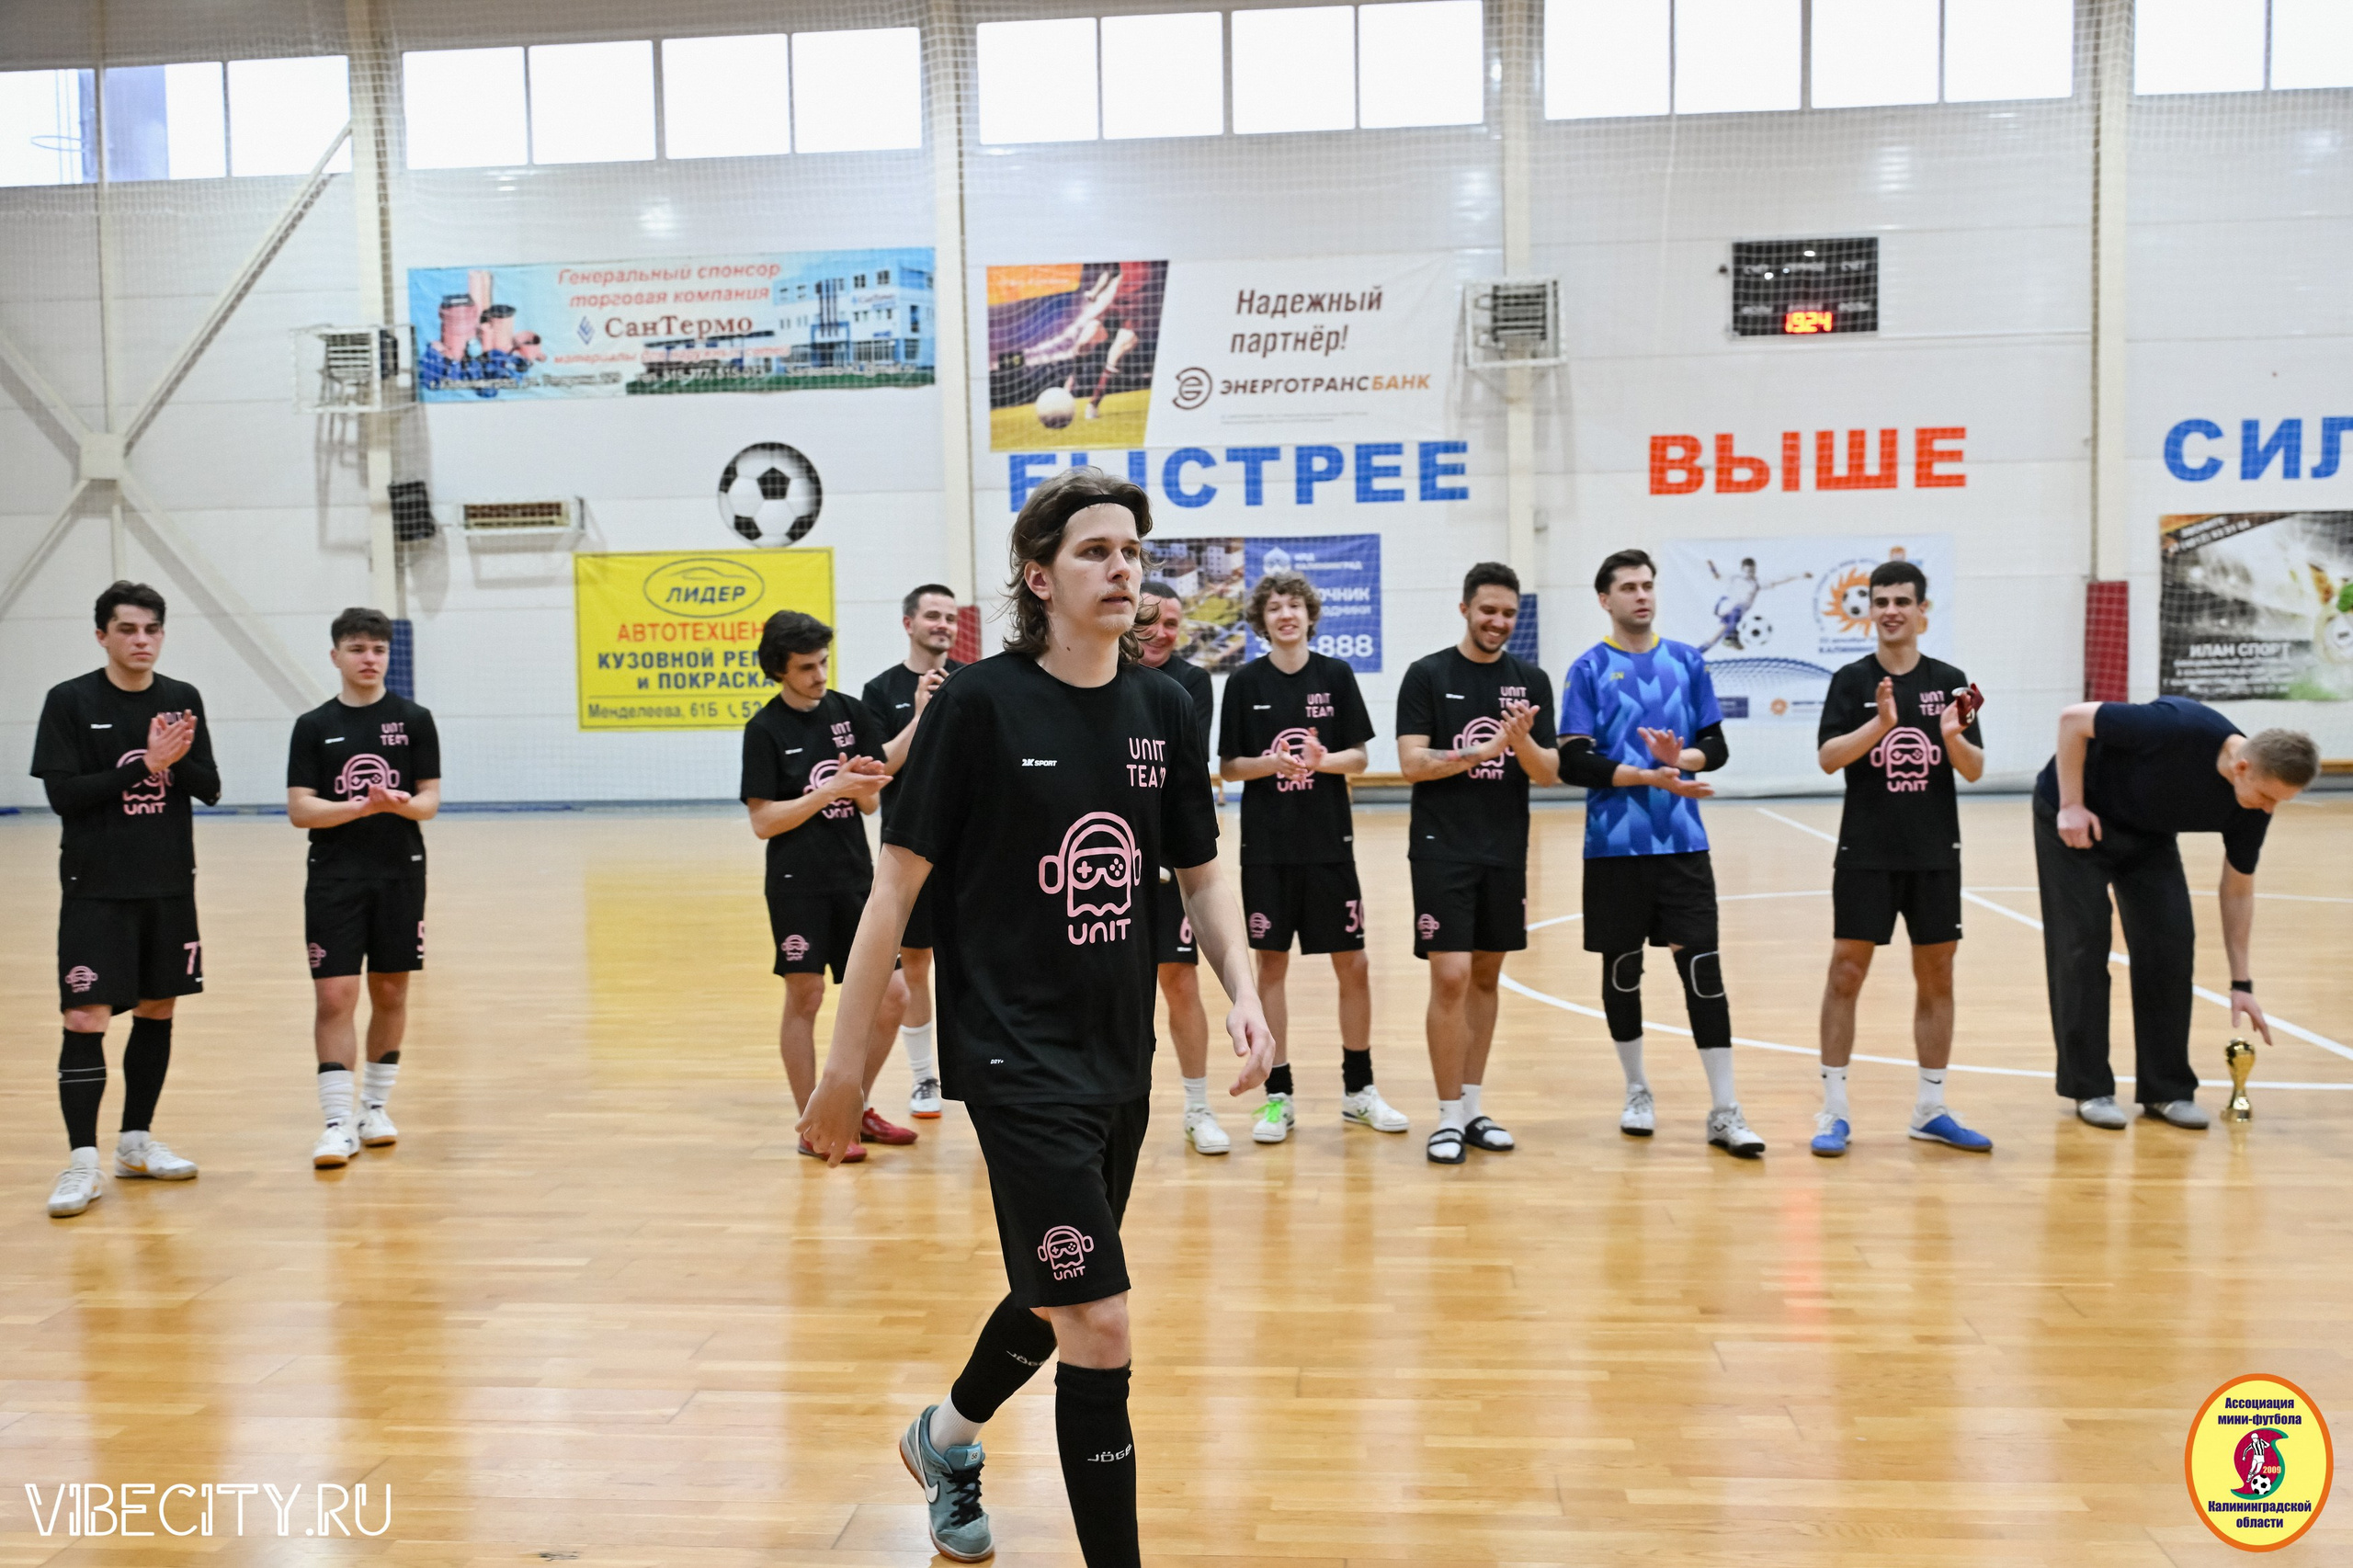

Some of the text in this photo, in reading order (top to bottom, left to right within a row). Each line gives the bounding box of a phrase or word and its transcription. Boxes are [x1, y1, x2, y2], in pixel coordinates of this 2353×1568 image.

[558, 263, 781, 287] Генеральный спонсор
[569, 288, 770, 309] торговая компания
[1236, 286, 1382, 317] Надежный
[605, 315, 753, 341] СанТермо
[1231, 324, 1348, 357] партнёр!
[1220, 373, 1431, 396] ЭНЕРГОТРАНСБАНК
[1649, 426, 1966, 495] ВЫШЕ
[665, 586, 745, 605] ЛИДЕР
[618, 621, 766, 643] АВТОТЕХЦЕН
[598, 647, 713, 669] КУЗОВНОЙ
[659, 671, 775, 689] ПОКРАСКА
[1129, 737, 1165, 762] UNIT
[1887, 779, 1929, 792] UNIT
[122, 802, 166, 816] UNIT
[1068, 918, 1131, 946] UNIT
[1053, 1266, 1086, 1280] UNIT
